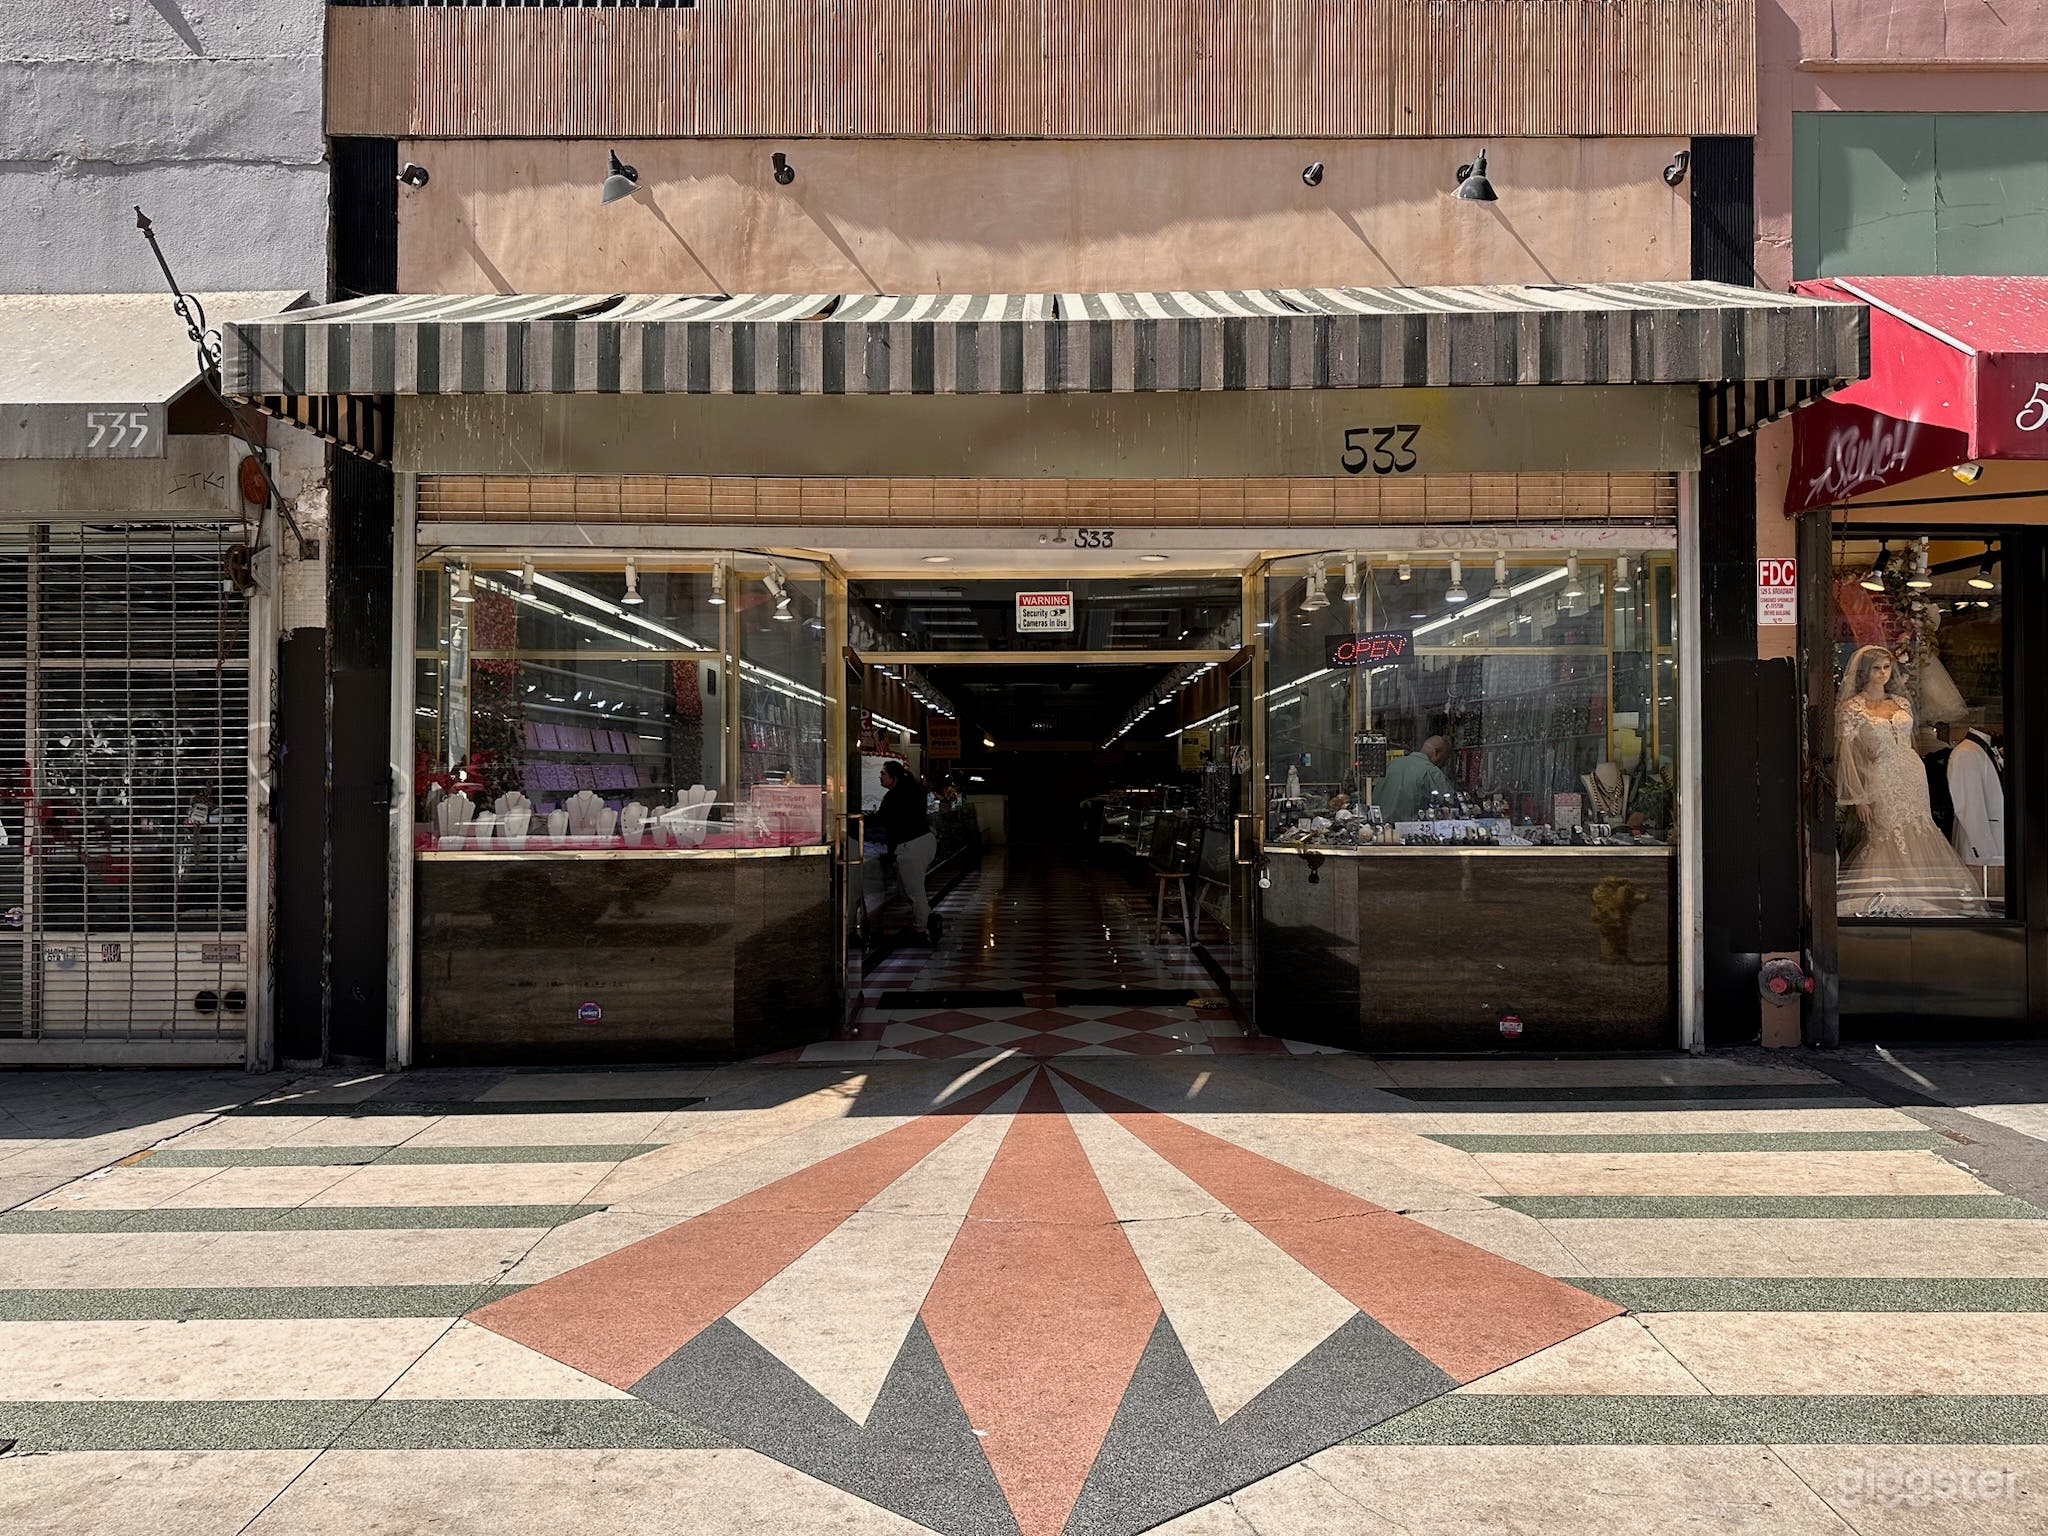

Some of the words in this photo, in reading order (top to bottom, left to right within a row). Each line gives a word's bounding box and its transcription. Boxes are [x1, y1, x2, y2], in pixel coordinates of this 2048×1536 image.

[86, 411, 150, 449] 535
[1340, 424, 1421, 475] 533
[1074, 528, 1115, 548] 533
[1759, 560, 1794, 586] FDC
[1022, 596, 1068, 605] WARNING
[1022, 609, 1048, 618] Security
[1022, 619, 1048, 627] Cameras
[1056, 619, 1067, 627] Use
[1336, 639, 1404, 660] OPEN
